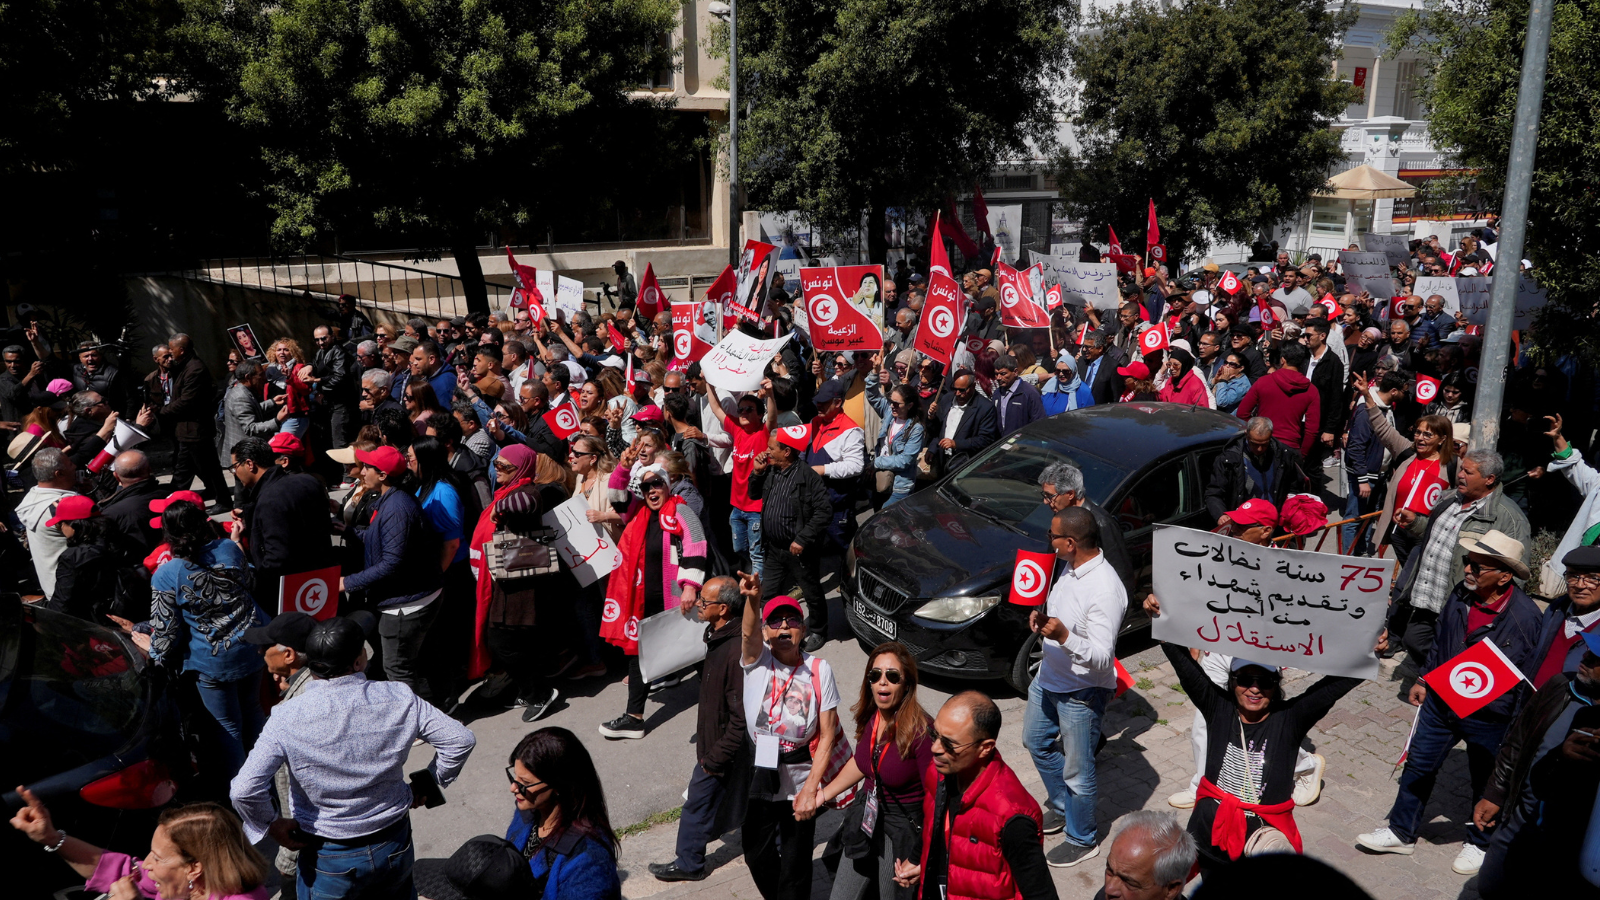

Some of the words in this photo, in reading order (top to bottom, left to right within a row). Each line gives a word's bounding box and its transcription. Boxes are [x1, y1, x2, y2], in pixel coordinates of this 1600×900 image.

[803, 275, 833, 292] تونس
[931, 282, 956, 302] تونس
[827, 323, 857, 337] الزعيمة
[1174, 541, 1261, 571] نضالات
[1179, 562, 1262, 600] شهداء
[1275, 559, 1326, 583] سنة
[1340, 564, 1385, 593] 75
[855, 600, 866, 617] 152
[876, 615, 894, 634] 8708
[1206, 594, 1264, 618] أجل
[1268, 592, 1366, 619] وتقديم
[1272, 612, 1311, 626] من
[1196, 615, 1324, 656] الاستقلال
